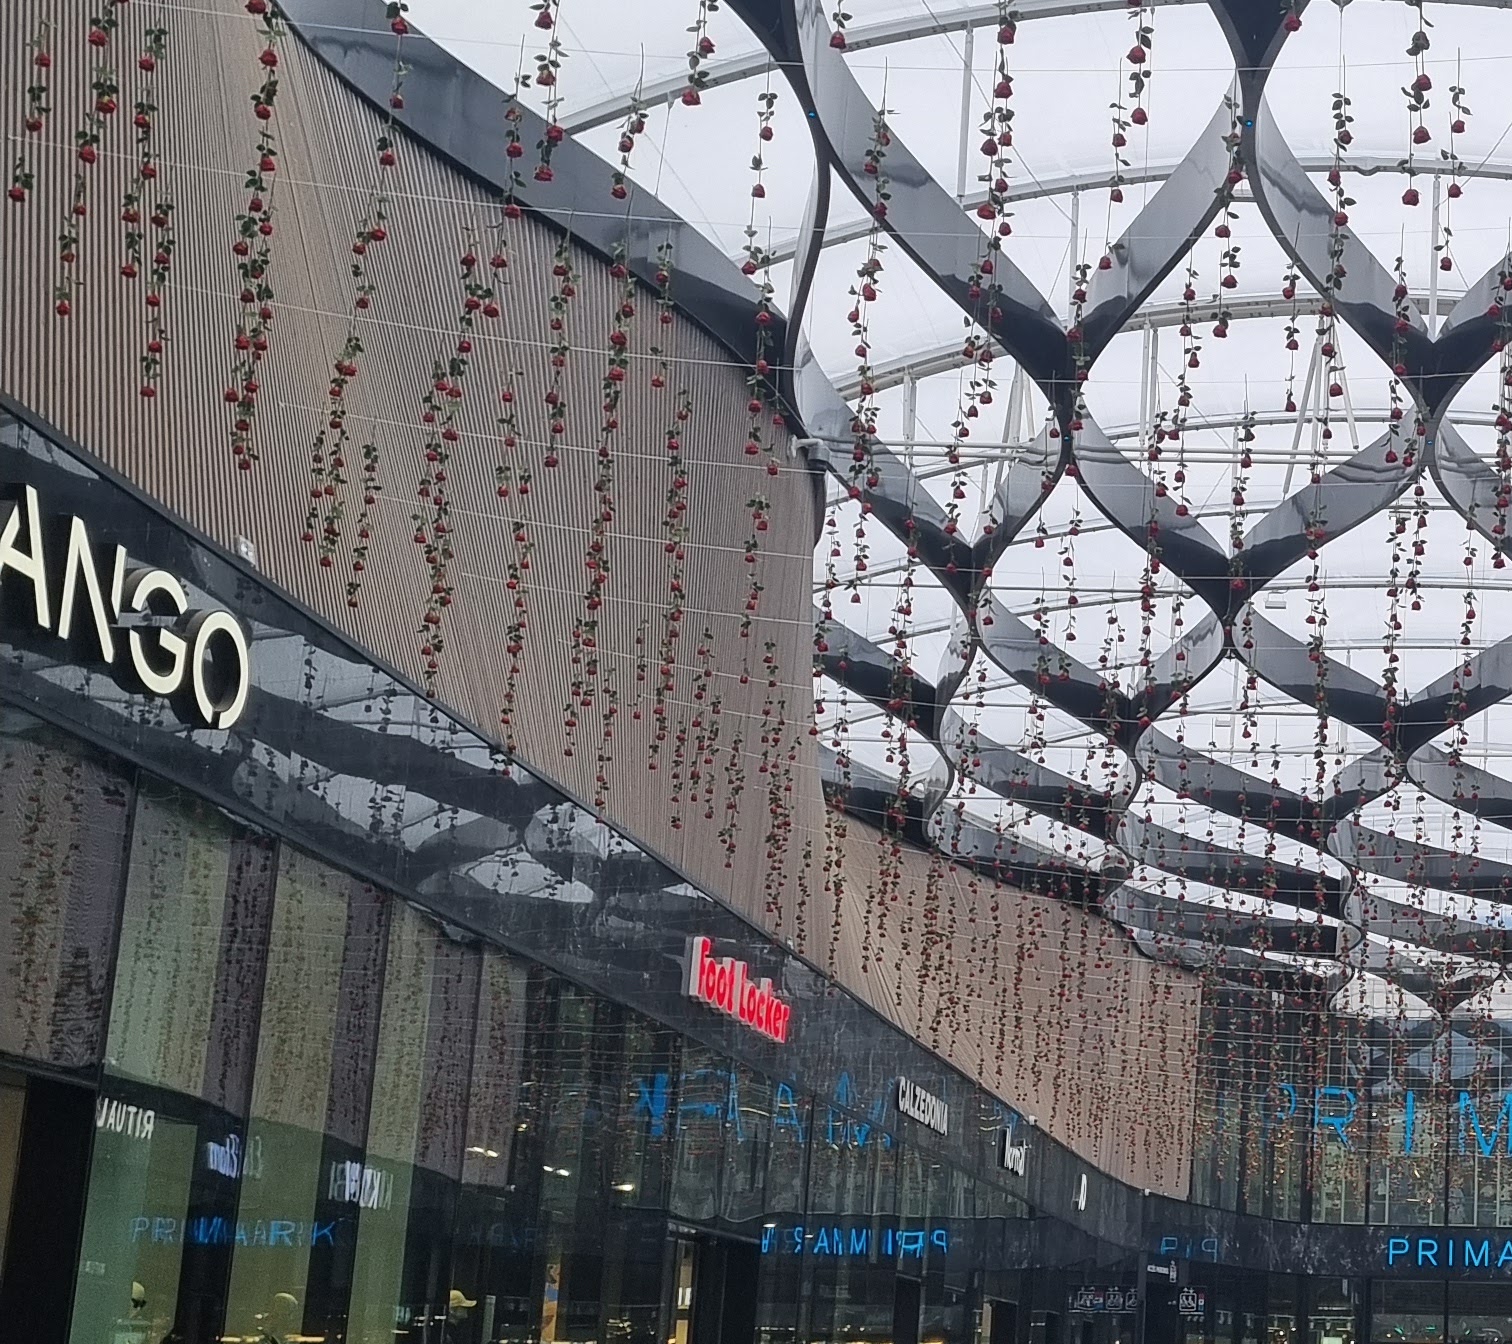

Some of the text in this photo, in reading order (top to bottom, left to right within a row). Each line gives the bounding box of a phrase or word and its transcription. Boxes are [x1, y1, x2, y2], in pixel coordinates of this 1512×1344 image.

[692, 937, 790, 1043] Foot Locker
[898, 1076, 948, 1136] CALZEDONIA
